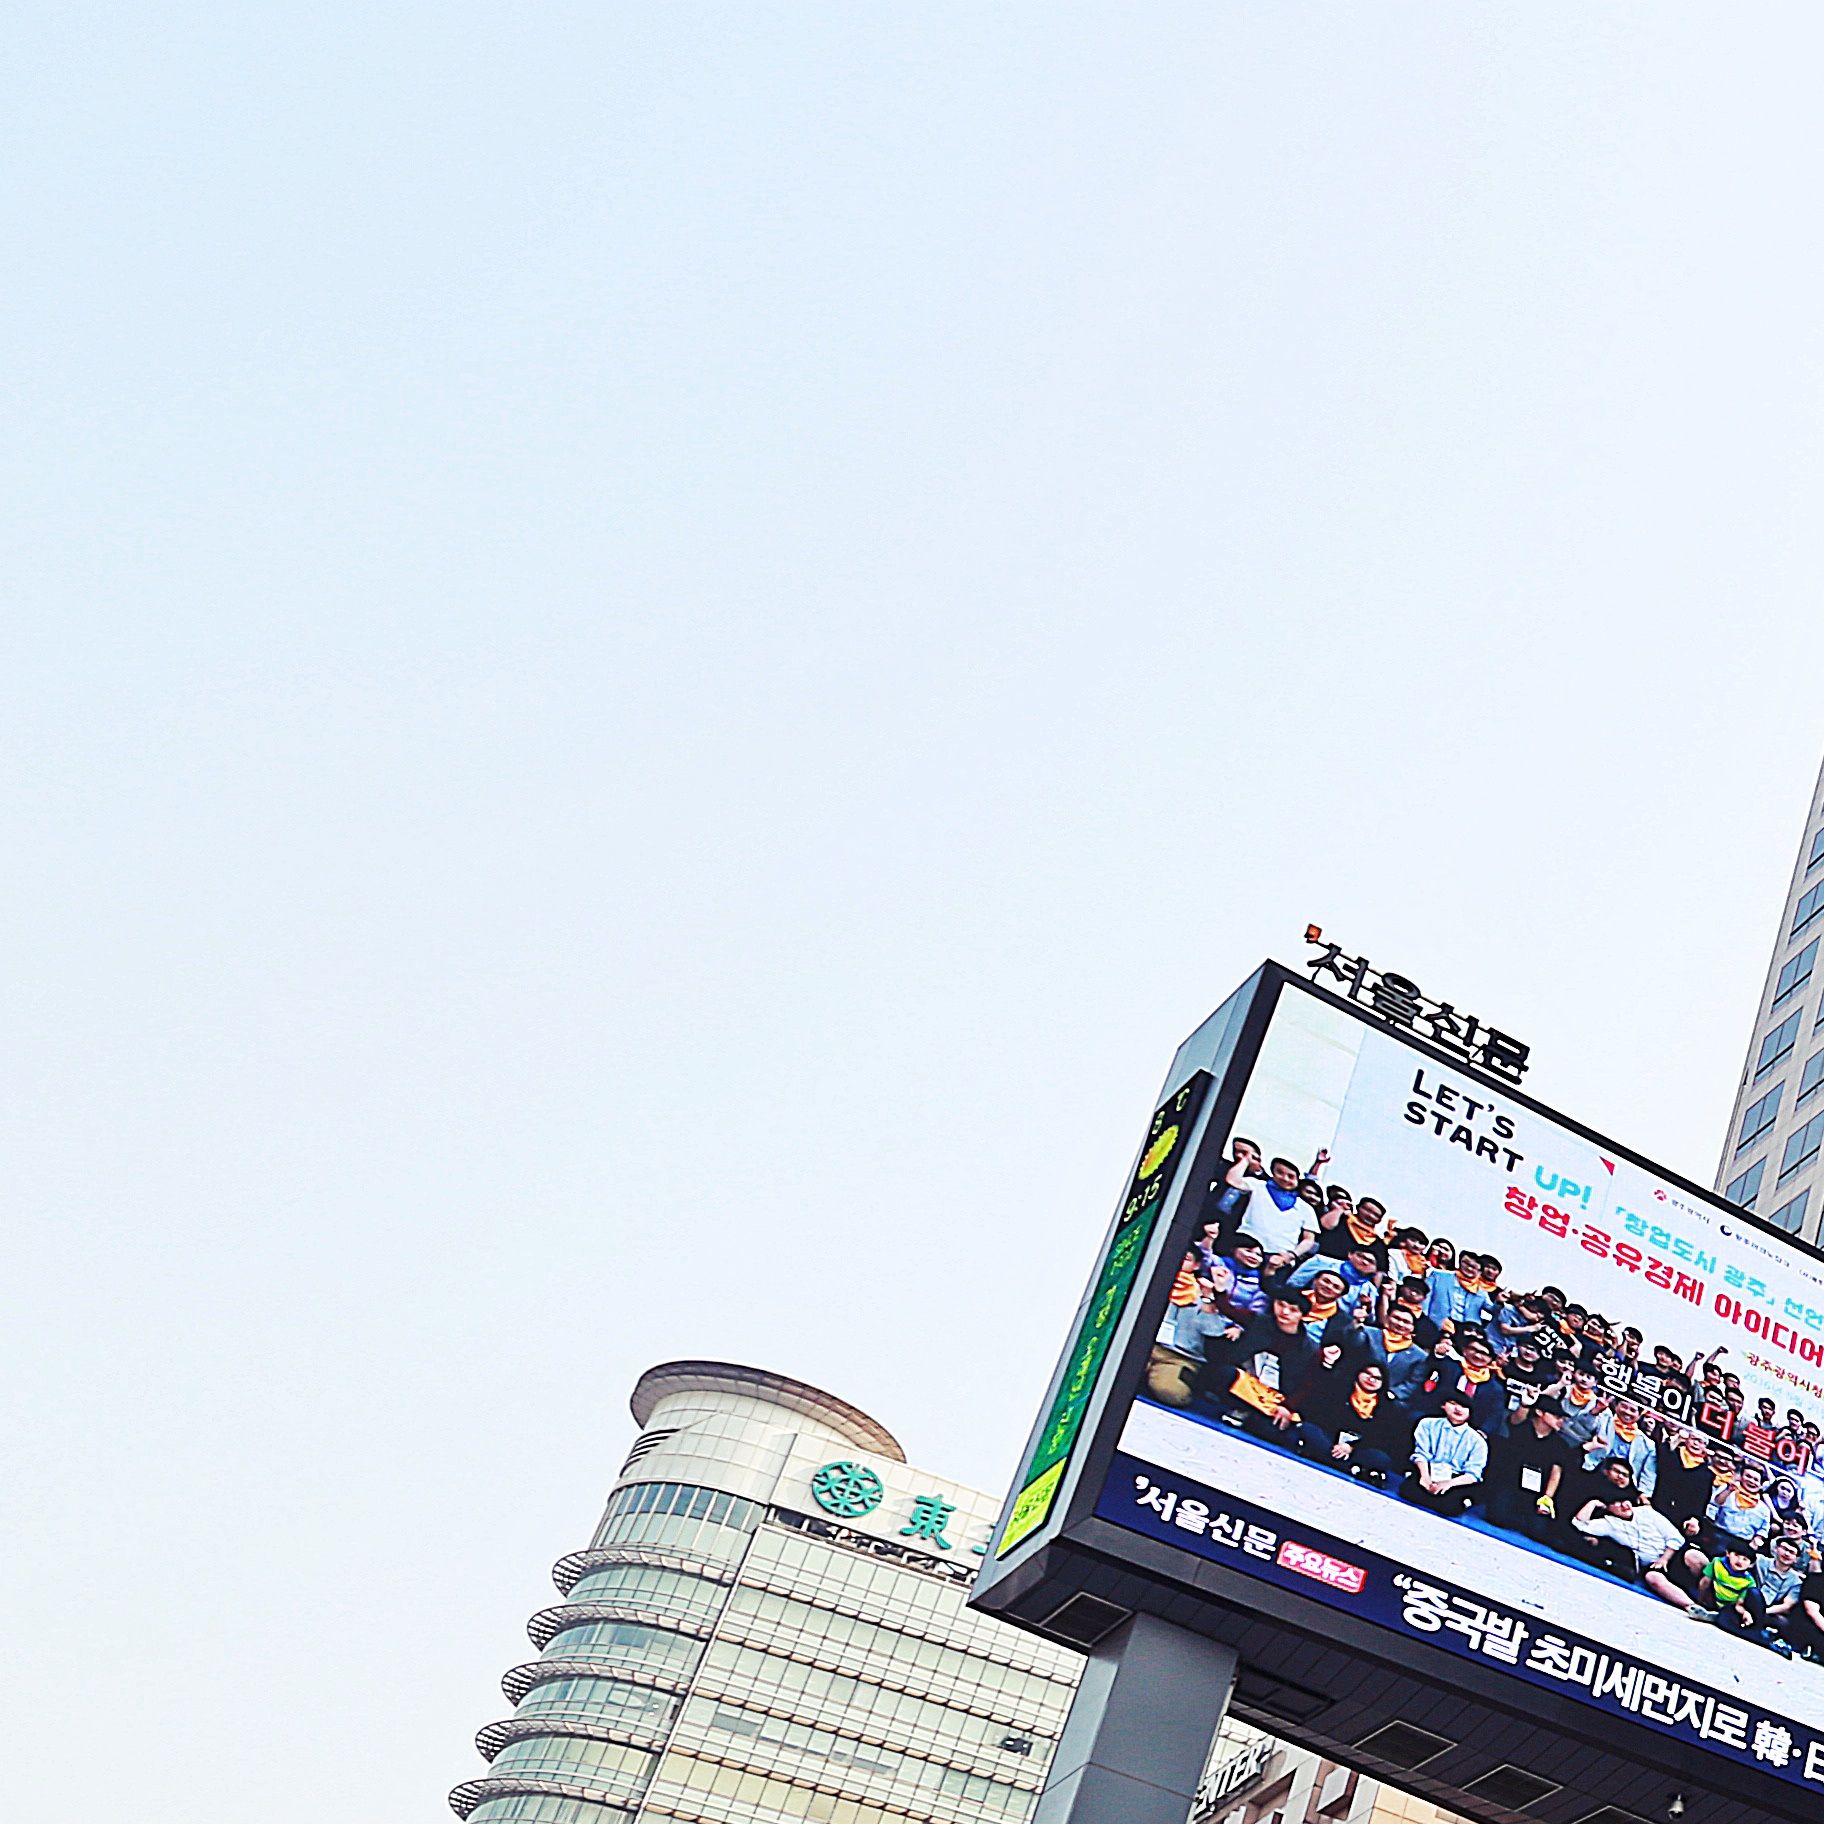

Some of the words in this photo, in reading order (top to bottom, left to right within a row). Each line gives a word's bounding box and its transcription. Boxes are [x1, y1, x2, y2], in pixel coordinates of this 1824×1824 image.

[1411, 1068, 1517, 1140] LET'S
[1403, 1100, 1525, 1173] START
[1533, 1164, 1594, 1211] UP!
[1599, 1355, 1693, 1423] 행복이
[1700, 1401, 1735, 1442] 더
[1282, 1543, 1362, 1590] 주요뉴스
[1525, 1633, 1748, 1752] 초미세먼지로
